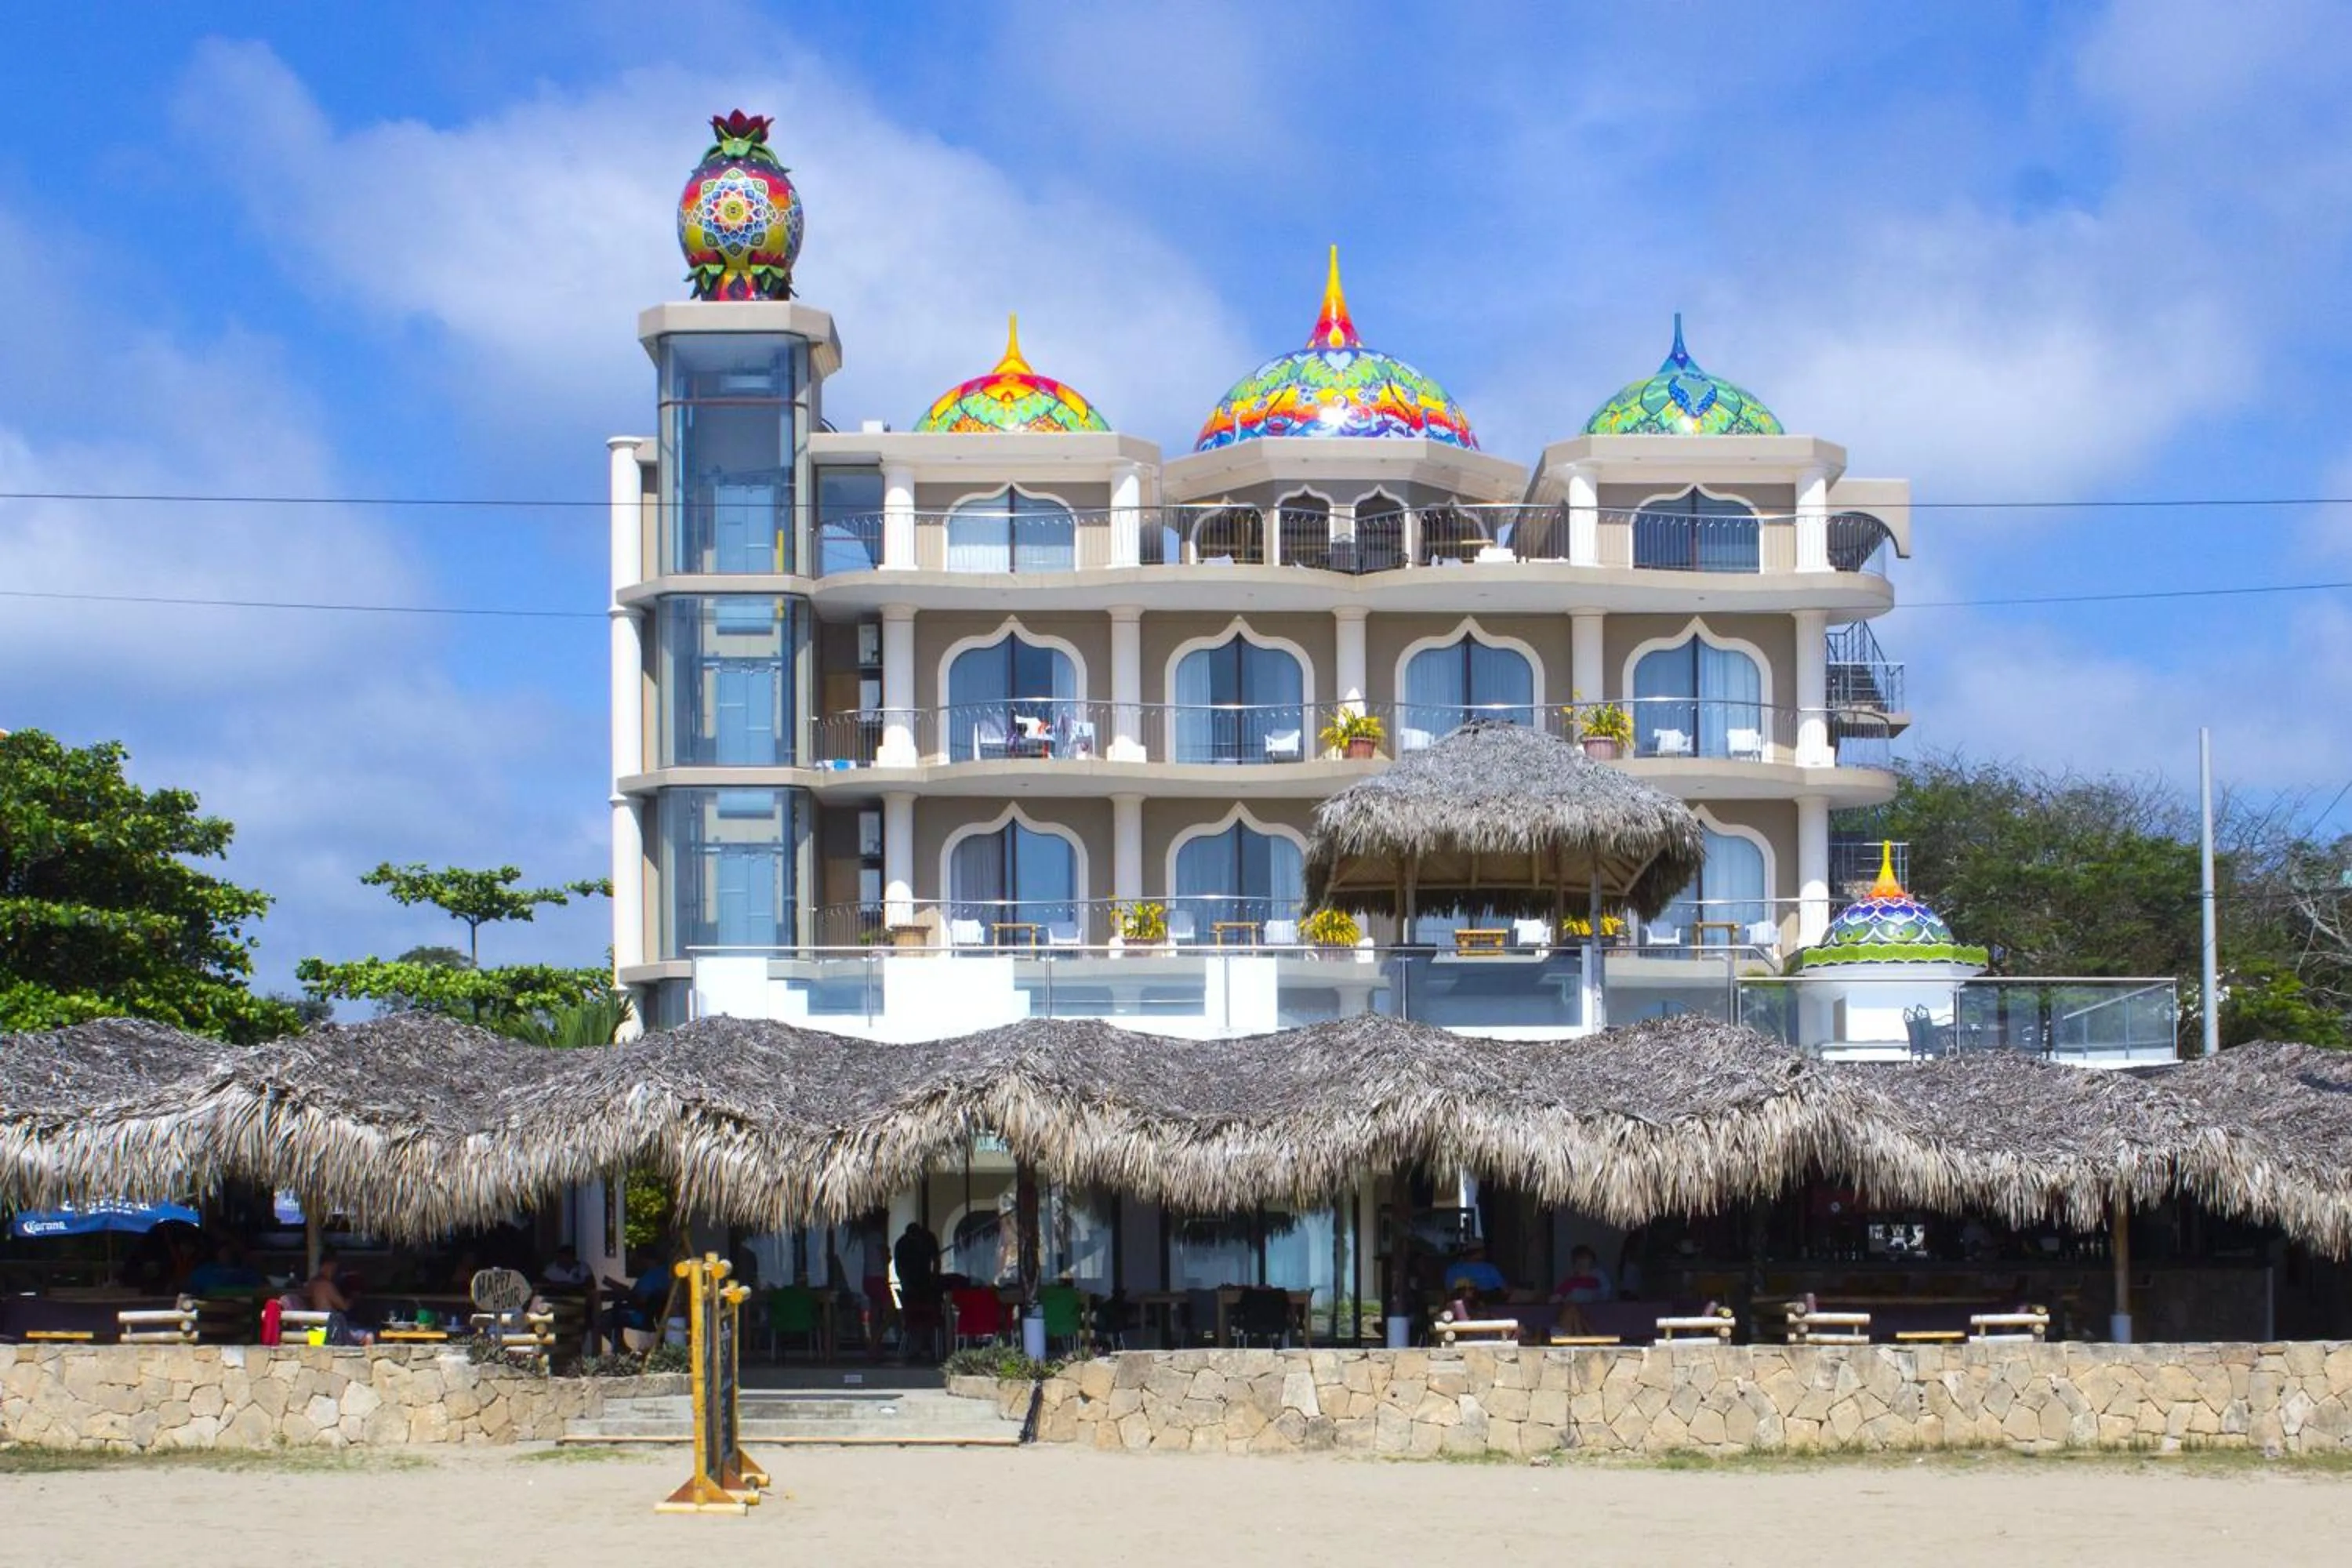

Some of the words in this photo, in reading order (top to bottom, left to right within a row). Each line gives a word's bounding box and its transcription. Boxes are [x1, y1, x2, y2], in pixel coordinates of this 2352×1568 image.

[23, 1220, 67, 1236] Corona
[476, 1271, 511, 1301] HAPPY
[493, 1286, 521, 1309] HOUR
